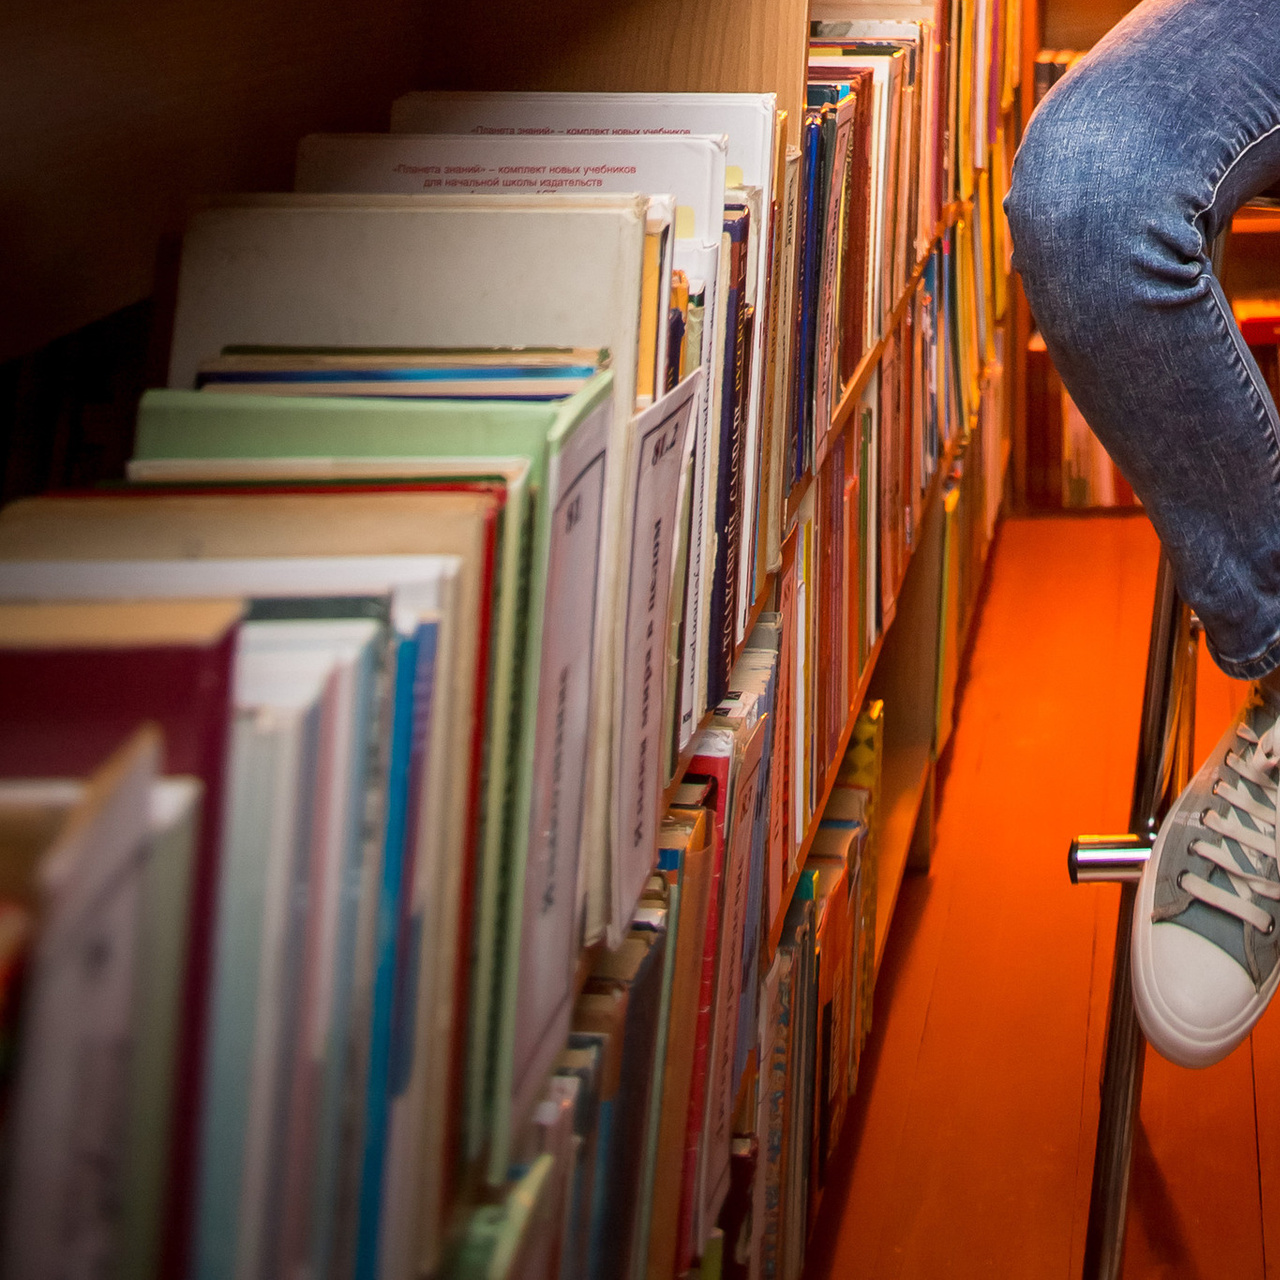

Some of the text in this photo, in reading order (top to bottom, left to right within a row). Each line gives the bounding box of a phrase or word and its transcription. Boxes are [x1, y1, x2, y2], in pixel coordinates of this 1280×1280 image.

[392, 163, 636, 177] «Планета знаний» комплект новых учебников
[424, 177, 603, 188] для начальной школы издательств
